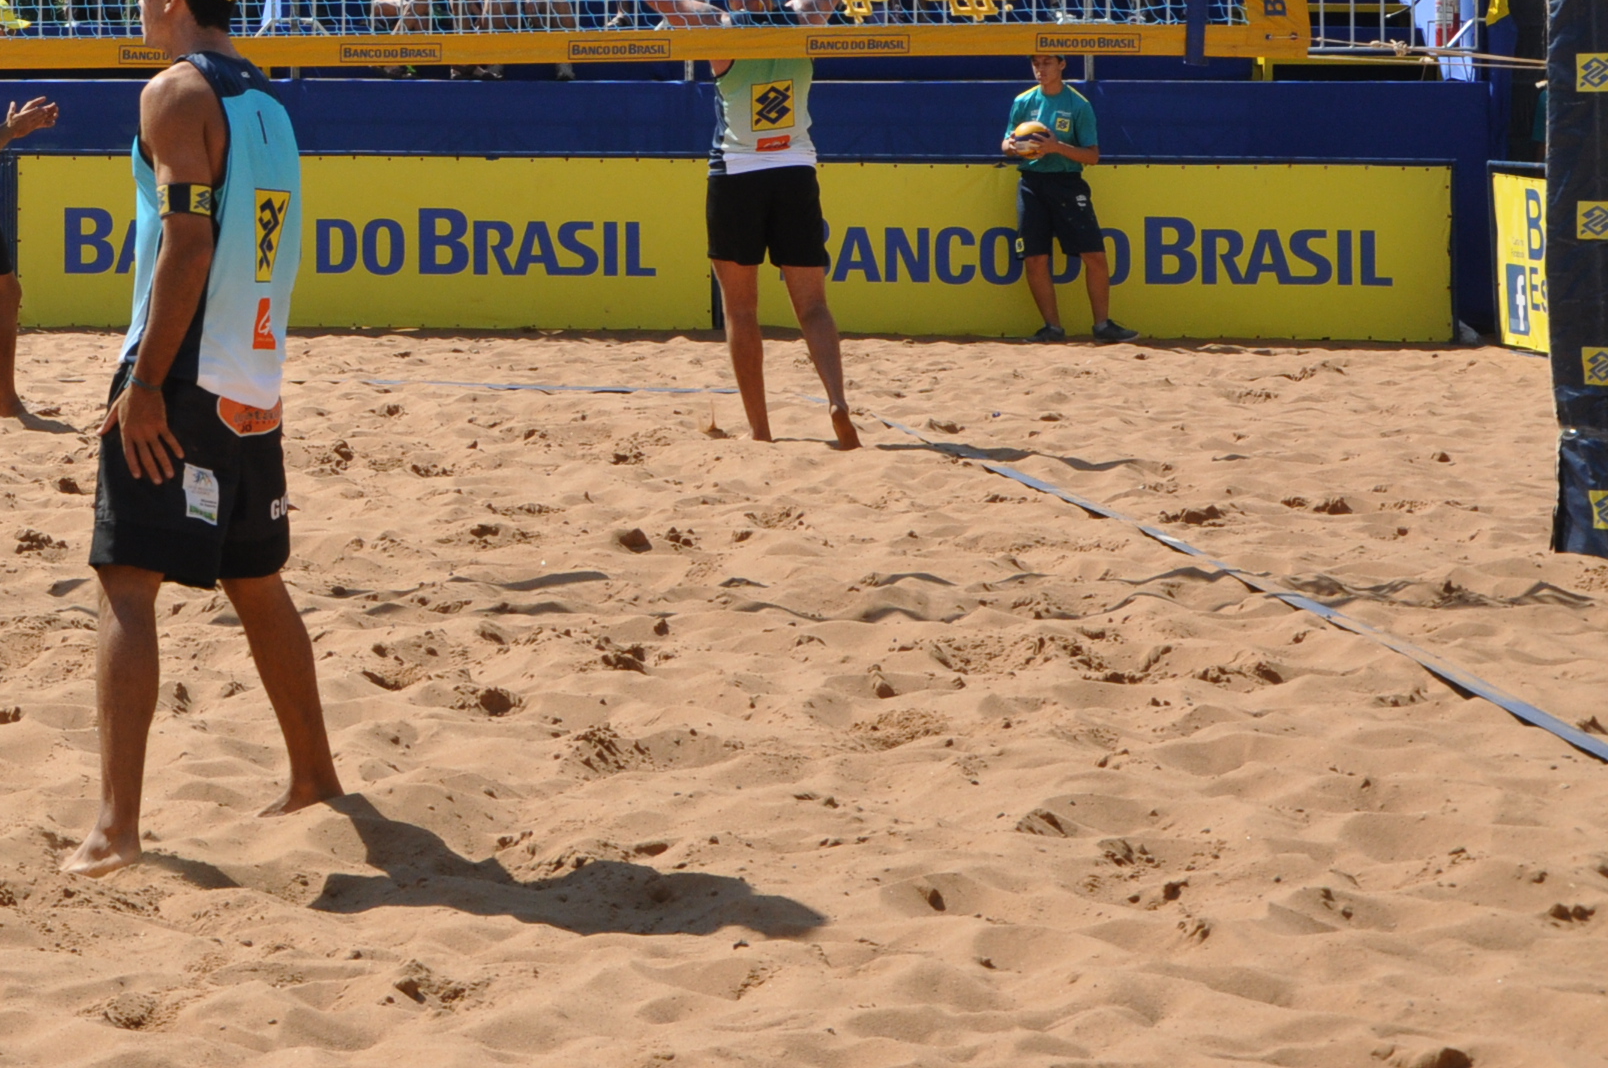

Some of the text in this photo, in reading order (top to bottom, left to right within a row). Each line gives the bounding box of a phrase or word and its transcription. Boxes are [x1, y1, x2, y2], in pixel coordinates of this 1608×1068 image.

[571, 42, 667, 58] BANCO DO BRASIL
[809, 36, 906, 52] BANCO DO BRASIL
[1038, 36, 1137, 51] BANCO DO BRASIL
[121, 47, 161, 61] BANCO
[343, 46, 439, 60] BANCO DO BRASIL
[315, 207, 657, 277] DO BRASIL
[780, 219, 1024, 283] ANCO
[1144, 216, 1392, 287] BRASIL
